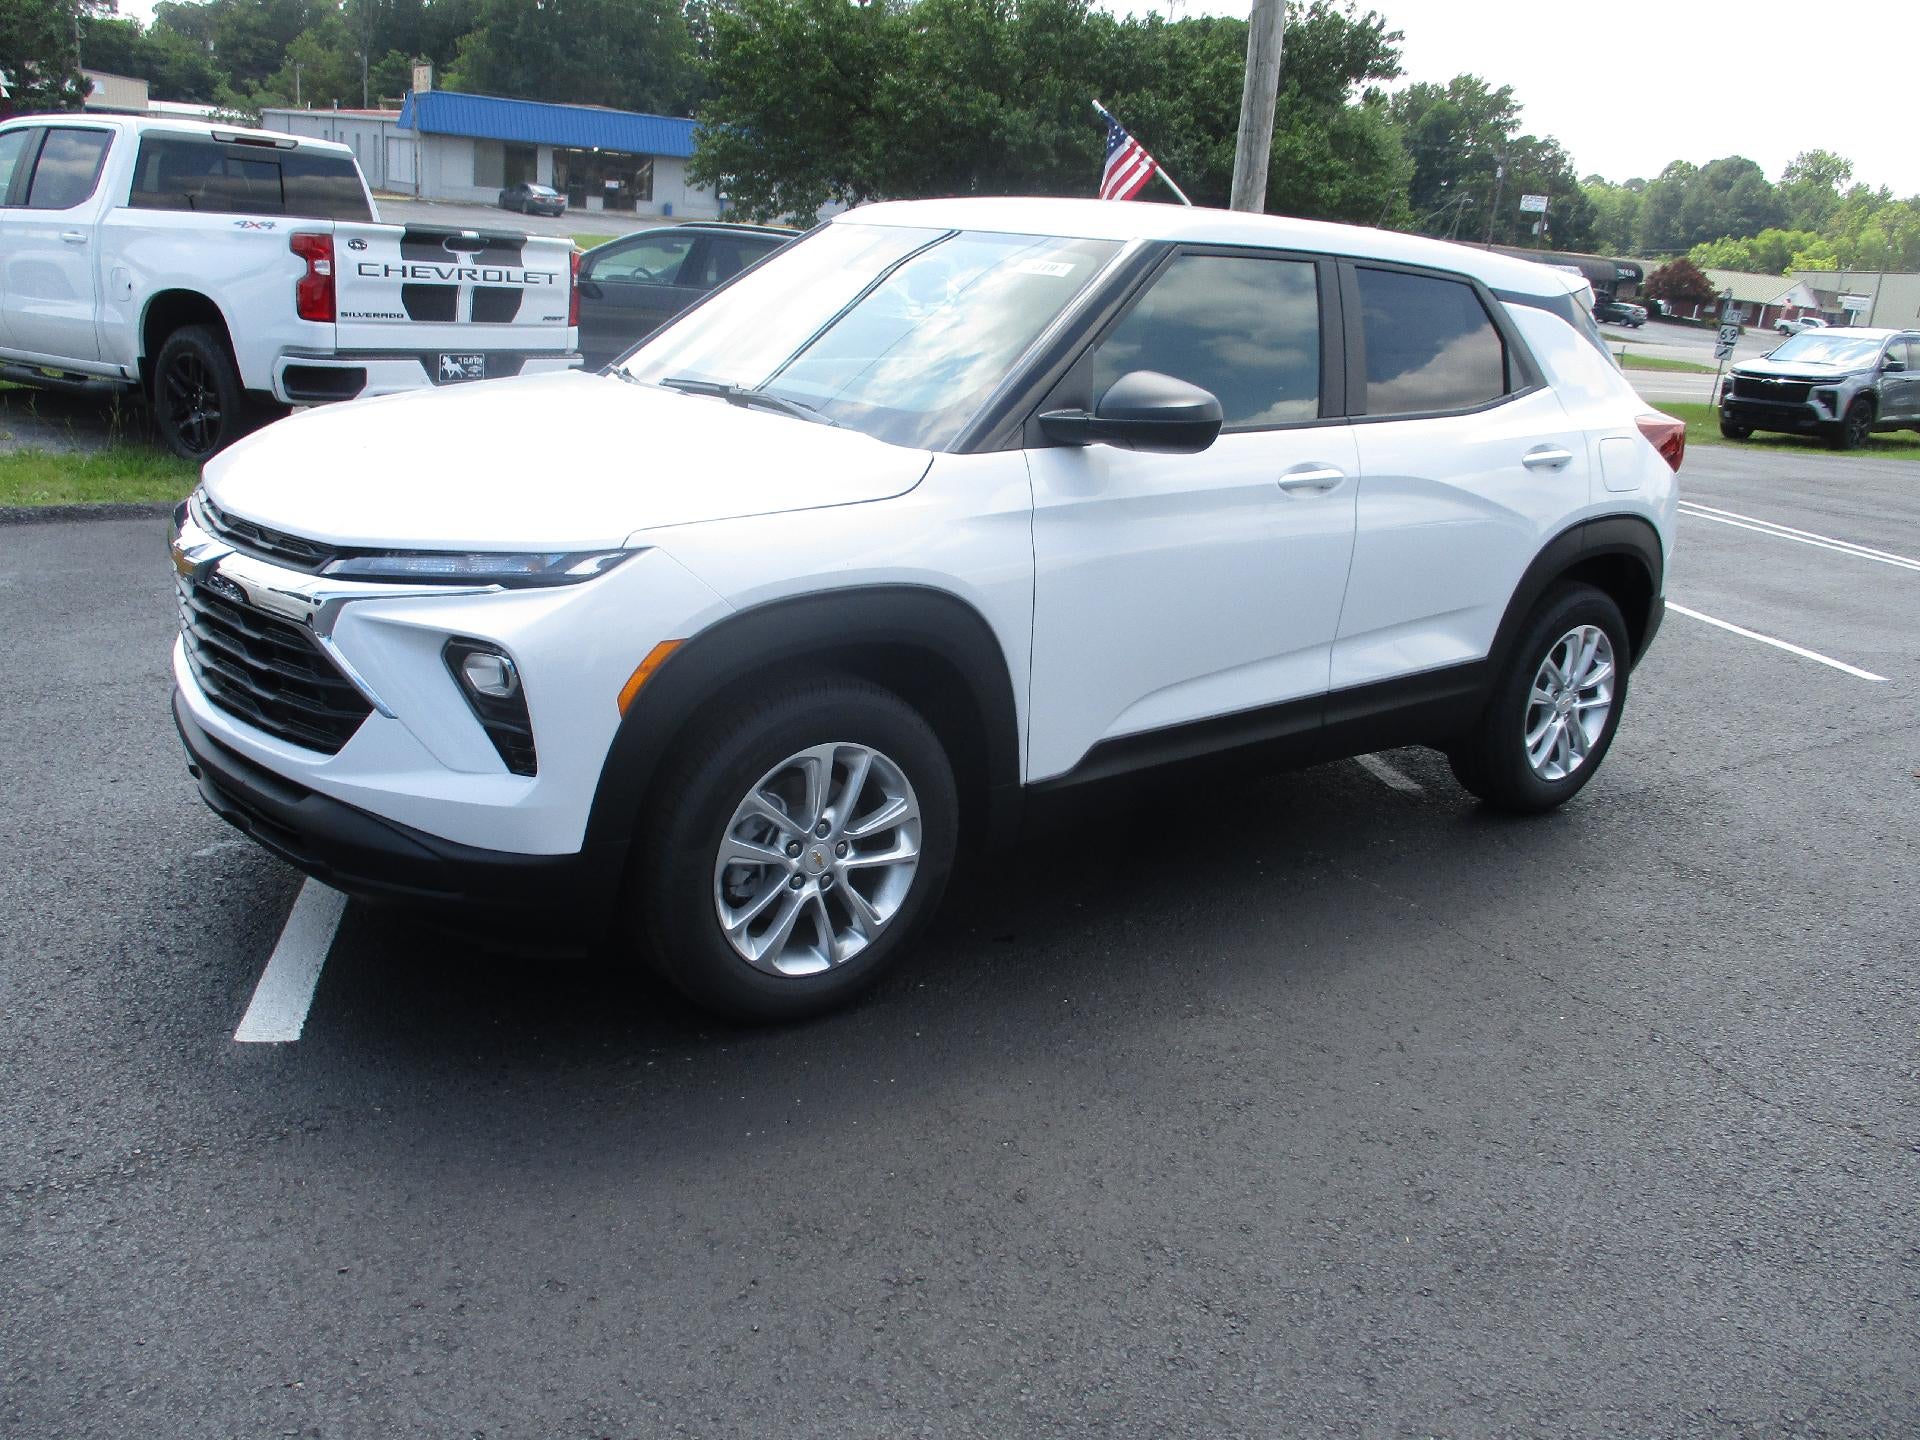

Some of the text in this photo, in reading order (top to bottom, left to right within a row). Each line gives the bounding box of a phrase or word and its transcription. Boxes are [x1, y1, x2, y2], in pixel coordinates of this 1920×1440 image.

[357, 262, 560, 285] CHEVROLET
[340, 311, 404, 319] SILVERADO
[1720, 328, 1737, 341] 69
